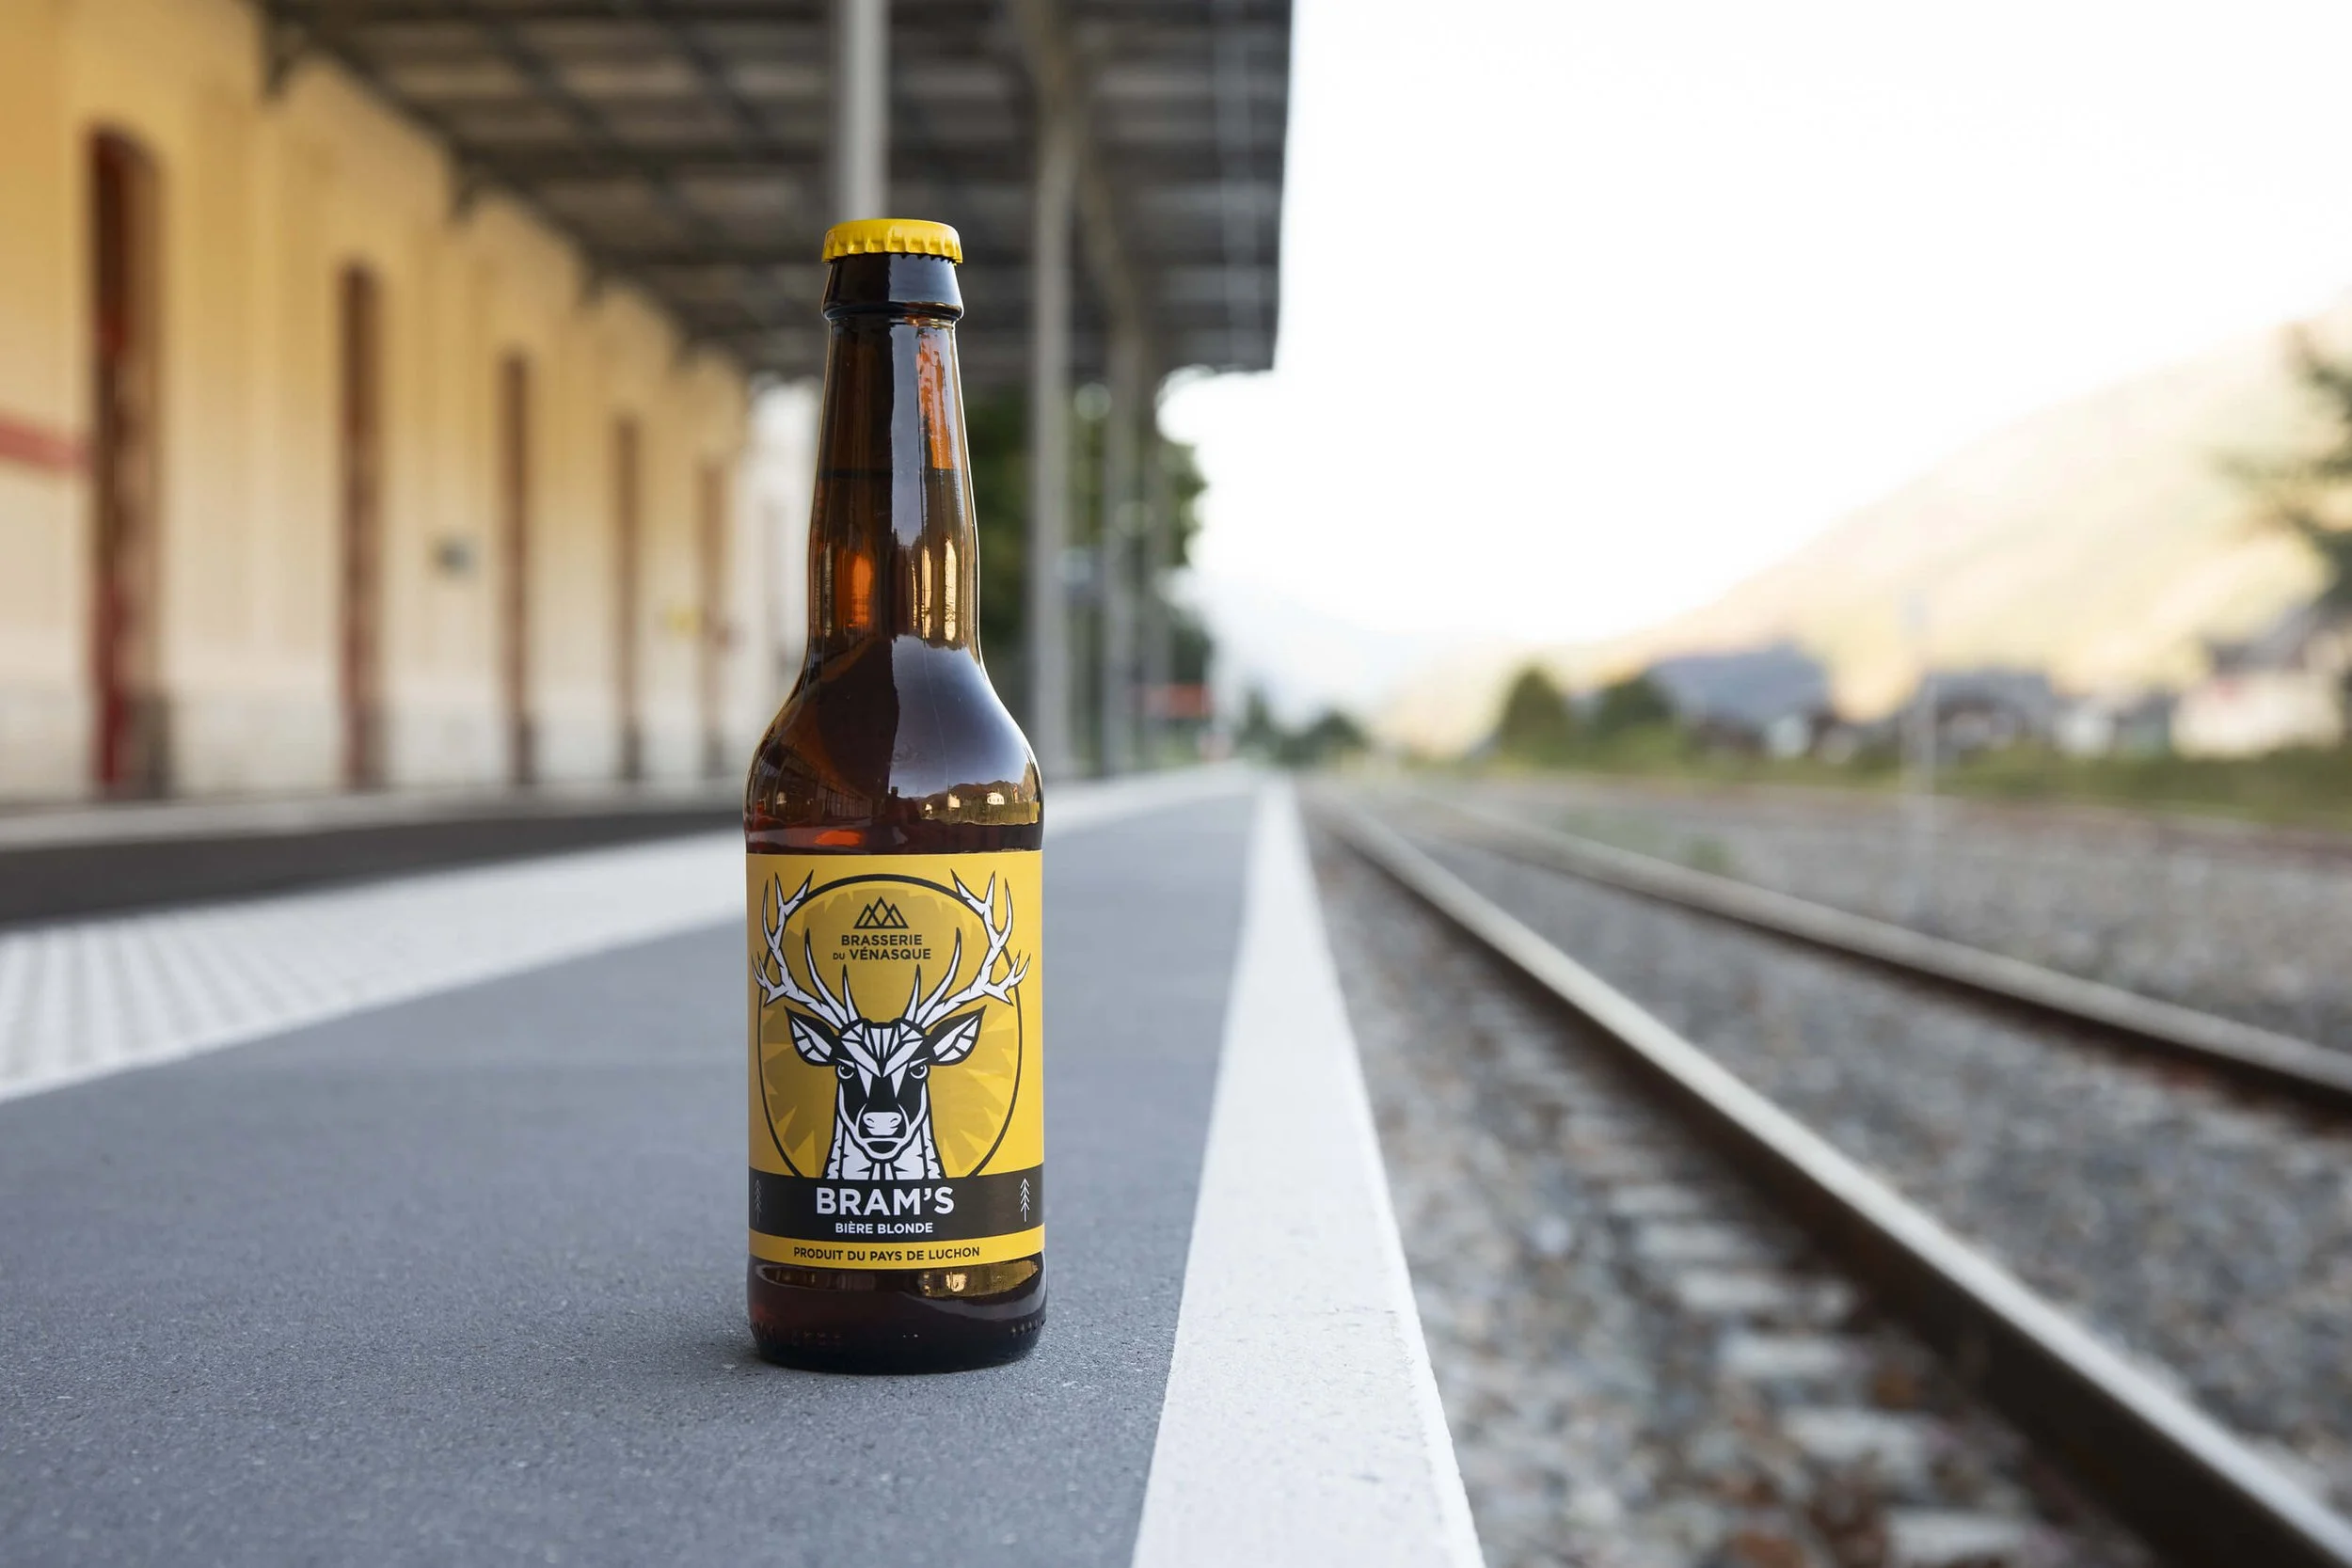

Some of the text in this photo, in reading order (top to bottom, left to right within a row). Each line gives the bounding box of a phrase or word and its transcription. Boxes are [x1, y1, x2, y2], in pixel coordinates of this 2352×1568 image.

[841, 934, 922, 946] BRASSERIE
[849, 947, 931, 960] VÉNASQUE
[816, 1187, 955, 1216] BRAM'S
[835, 1221, 933, 1234] BIÈRE BLONDE
[793, 1246, 980, 1261] PRODUIT DU PAYS DE LUCHON
